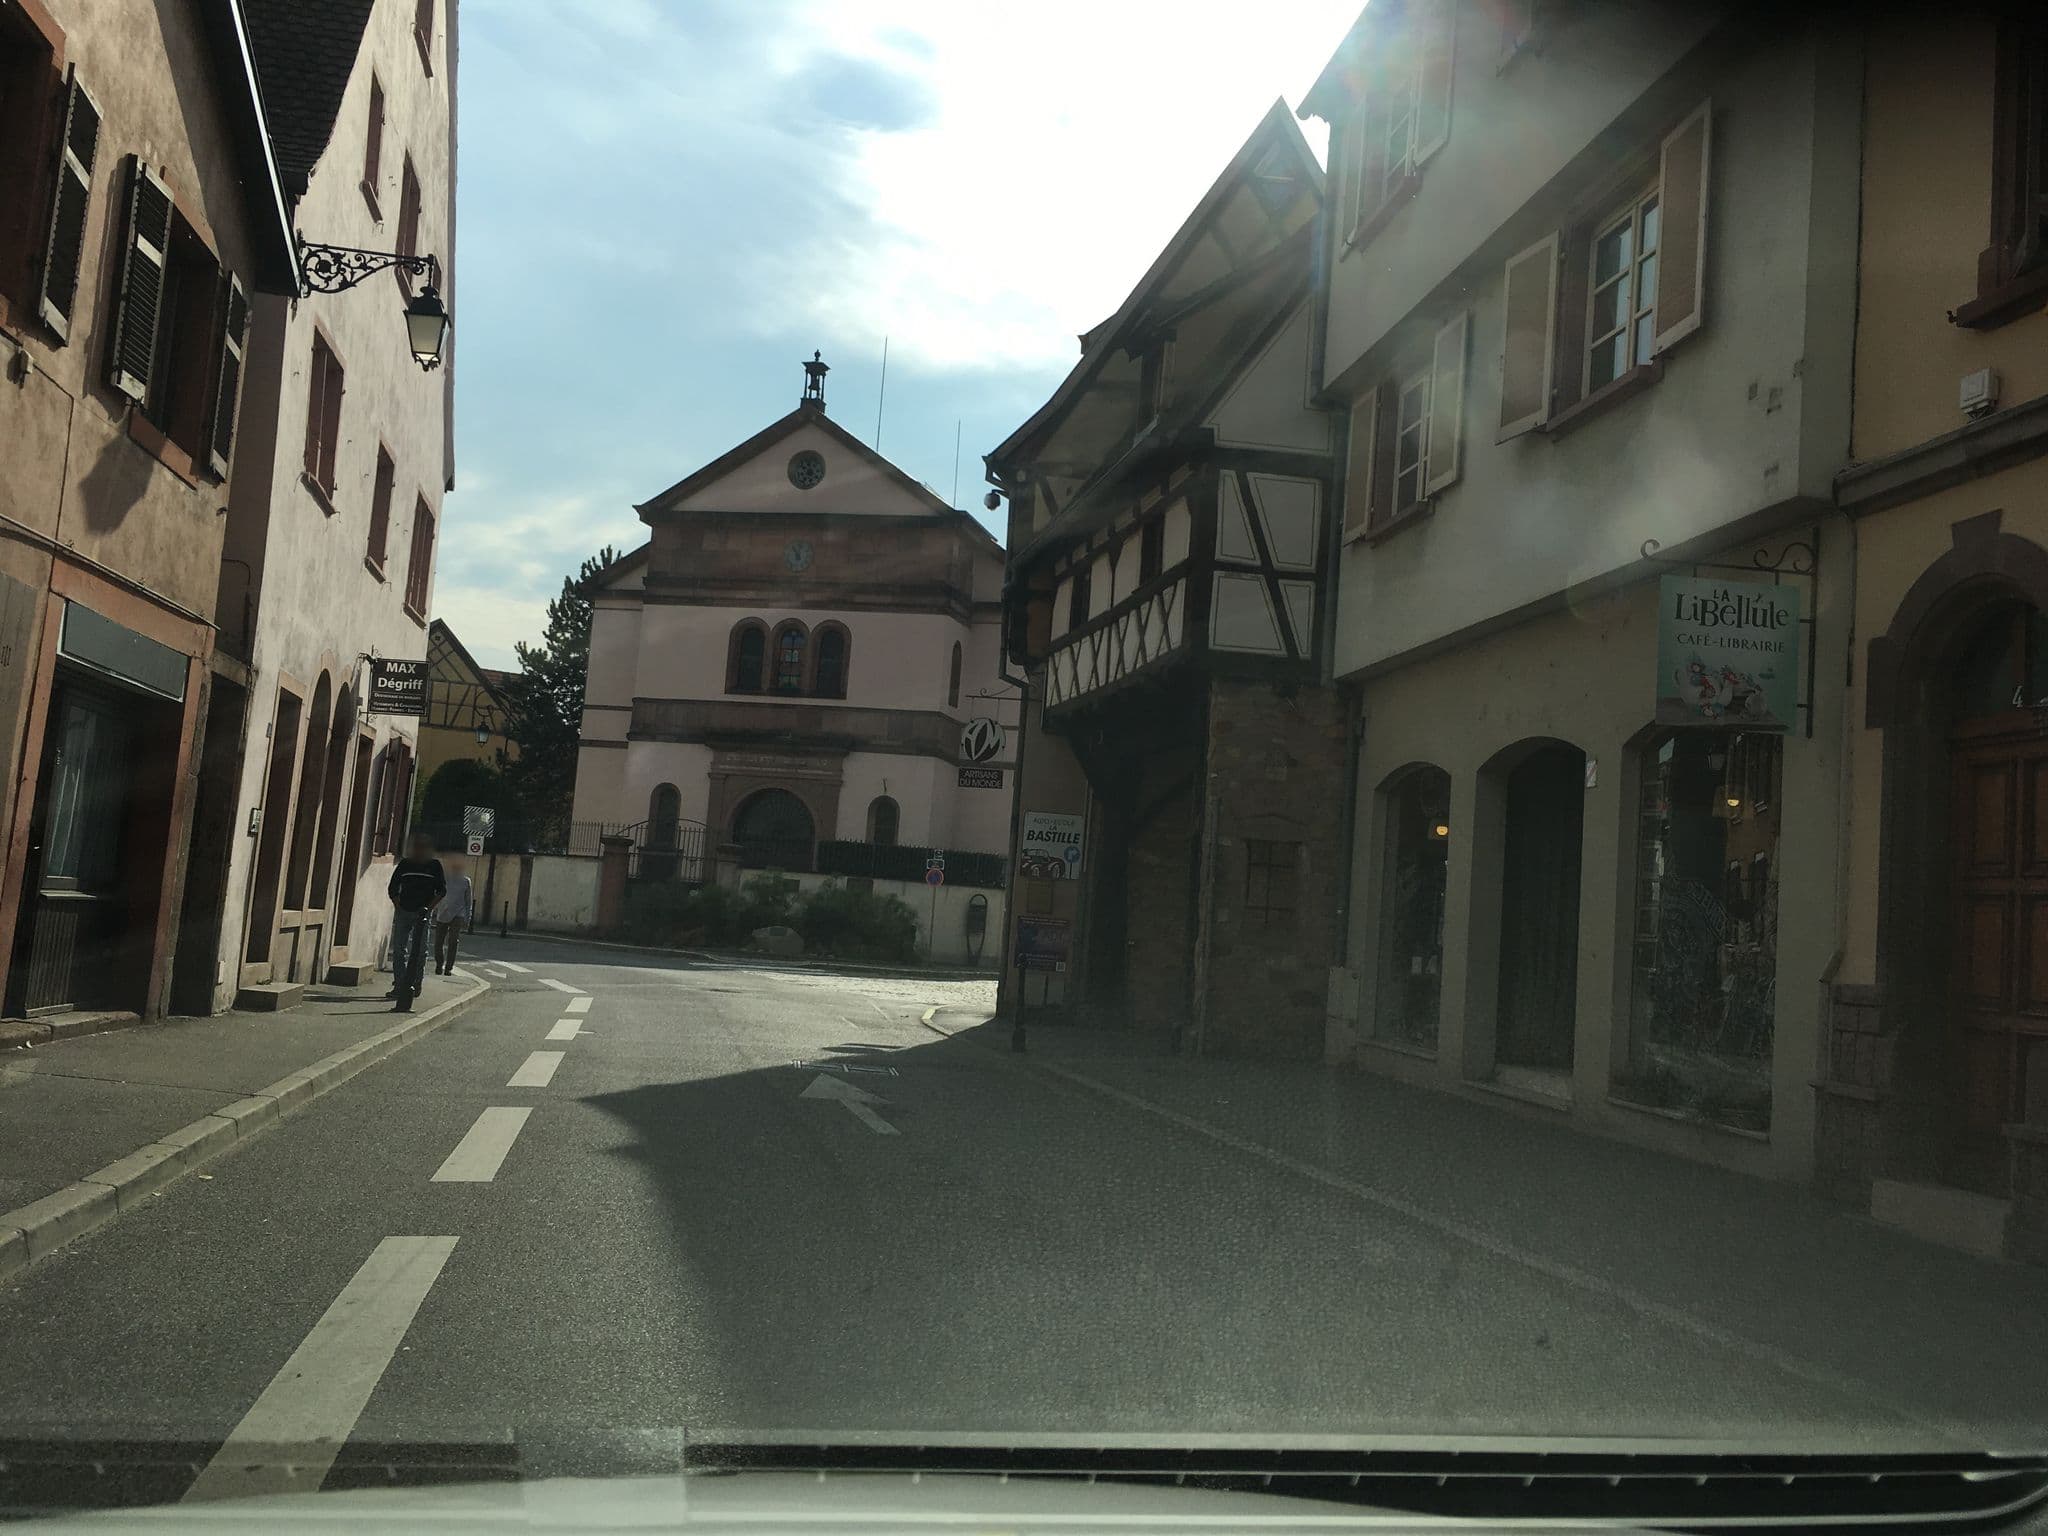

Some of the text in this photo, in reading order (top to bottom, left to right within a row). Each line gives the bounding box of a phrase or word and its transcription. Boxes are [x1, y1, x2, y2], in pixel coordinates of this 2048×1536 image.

[1713, 589, 1730, 602] LA
[1676, 632, 1785, 653] CAFÉ-LIBRAIRIE
[386, 662, 416, 674] MAX
[378, 677, 423, 691] Dégriff
[2012, 685, 2023, 707] 4
[1026, 830, 1080, 844] BASTILLE
